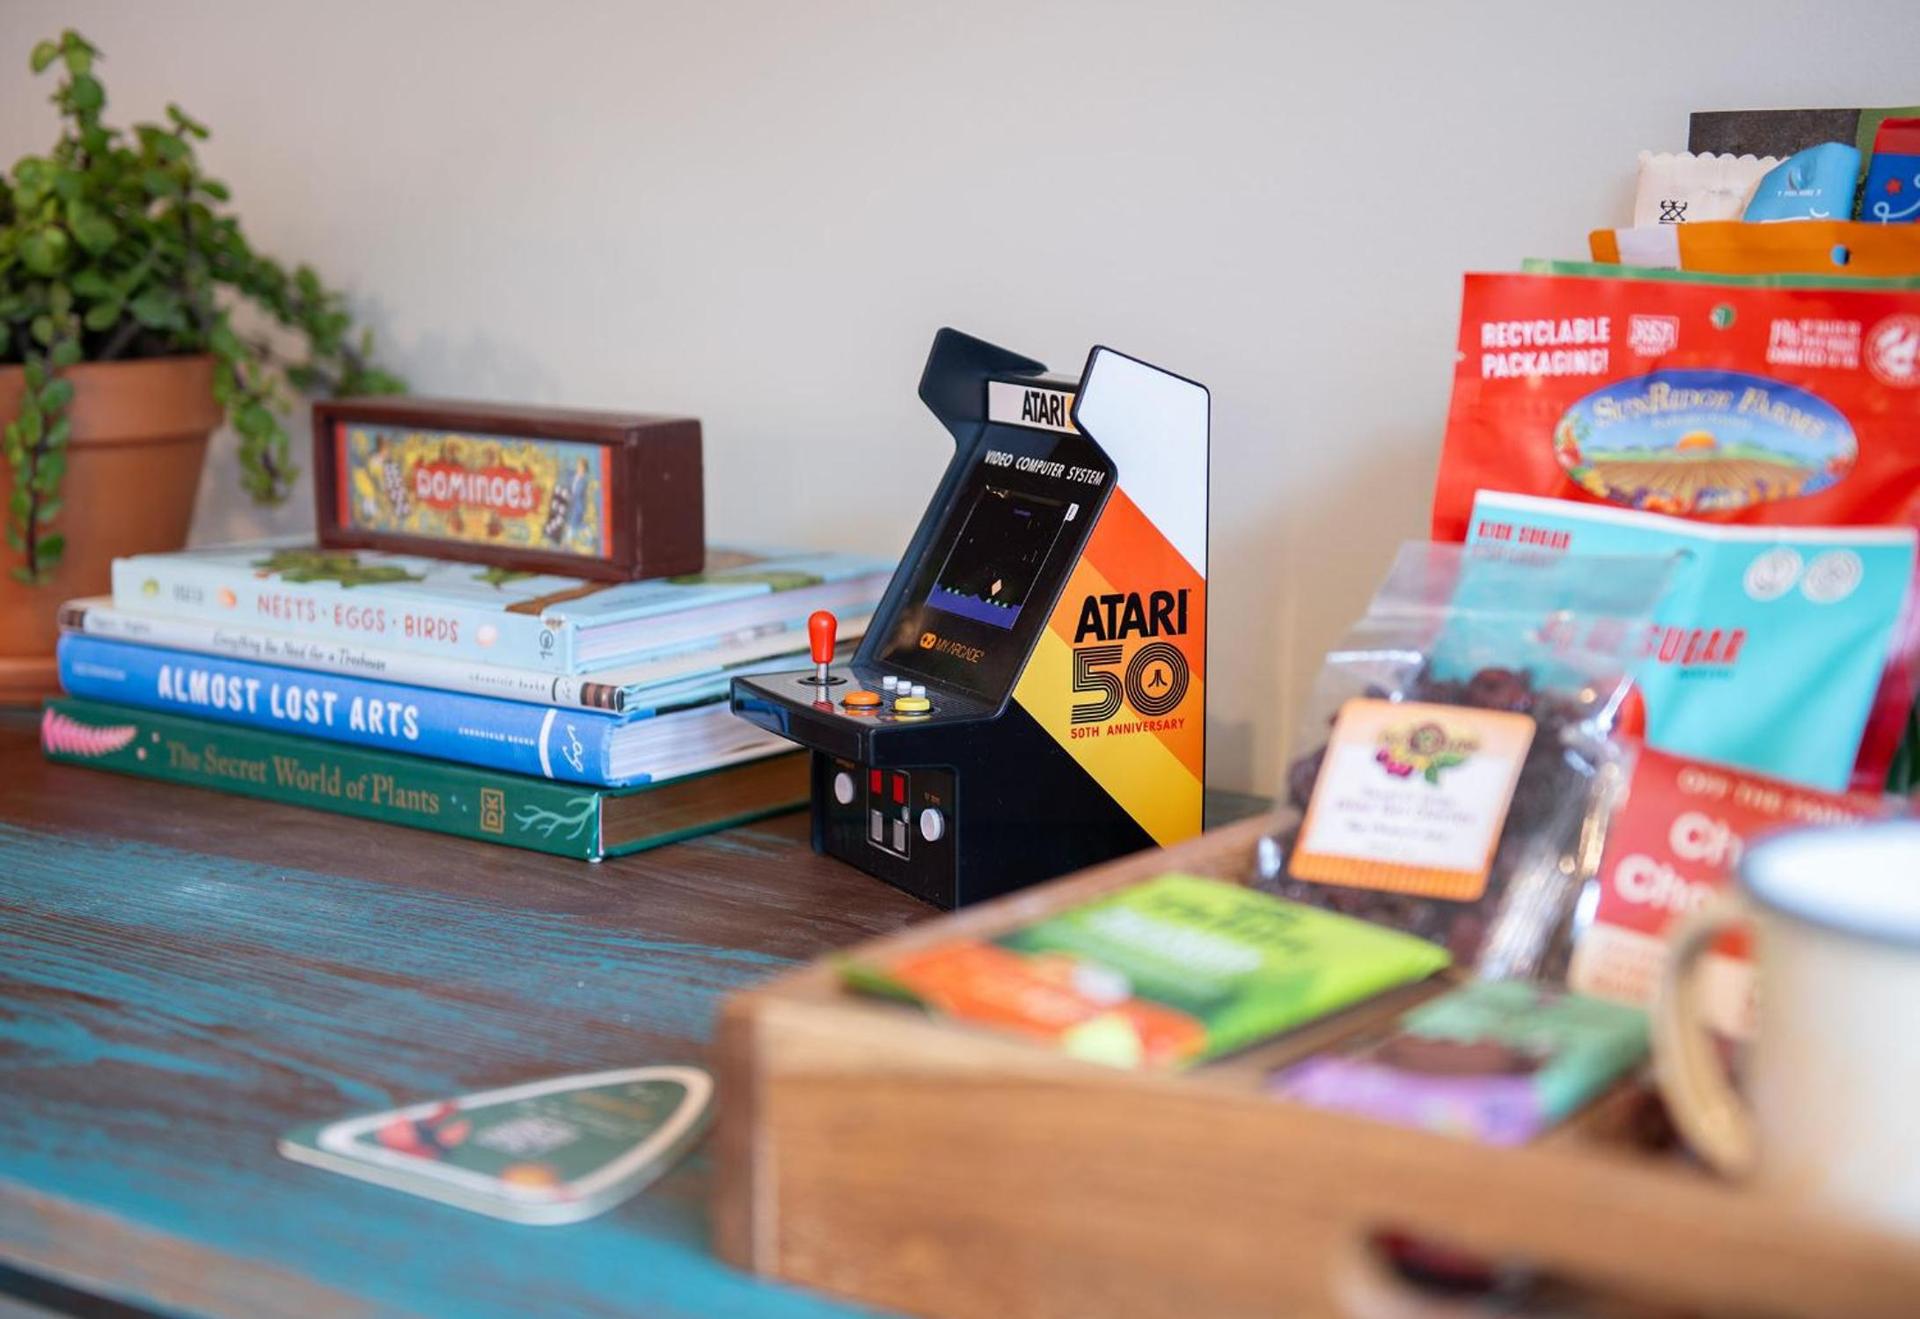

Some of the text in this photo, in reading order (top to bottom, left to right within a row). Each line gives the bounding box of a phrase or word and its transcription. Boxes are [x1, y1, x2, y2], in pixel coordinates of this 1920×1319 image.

[1480, 317, 1611, 348] RECYCLABLE
[1481, 348, 1609, 379] PACKAGING!
[1021, 389, 1066, 427] ATARI
[984, 450, 1105, 486] VIDEO COMPUTER SYSTEM
[257, 594, 459, 643] NESTS EGGS BIRDS
[1073, 589, 1188, 643] ATARI
[157, 664, 260, 714] ALMOST
[270, 683, 338, 727] LOST
[350, 696, 419, 740] ARTS
[1071, 642, 1189, 724] 50
[1070, 718, 1185, 739] 50TH ANNIVERSARY
[167, 740, 440, 815] The Secret World of Plants
